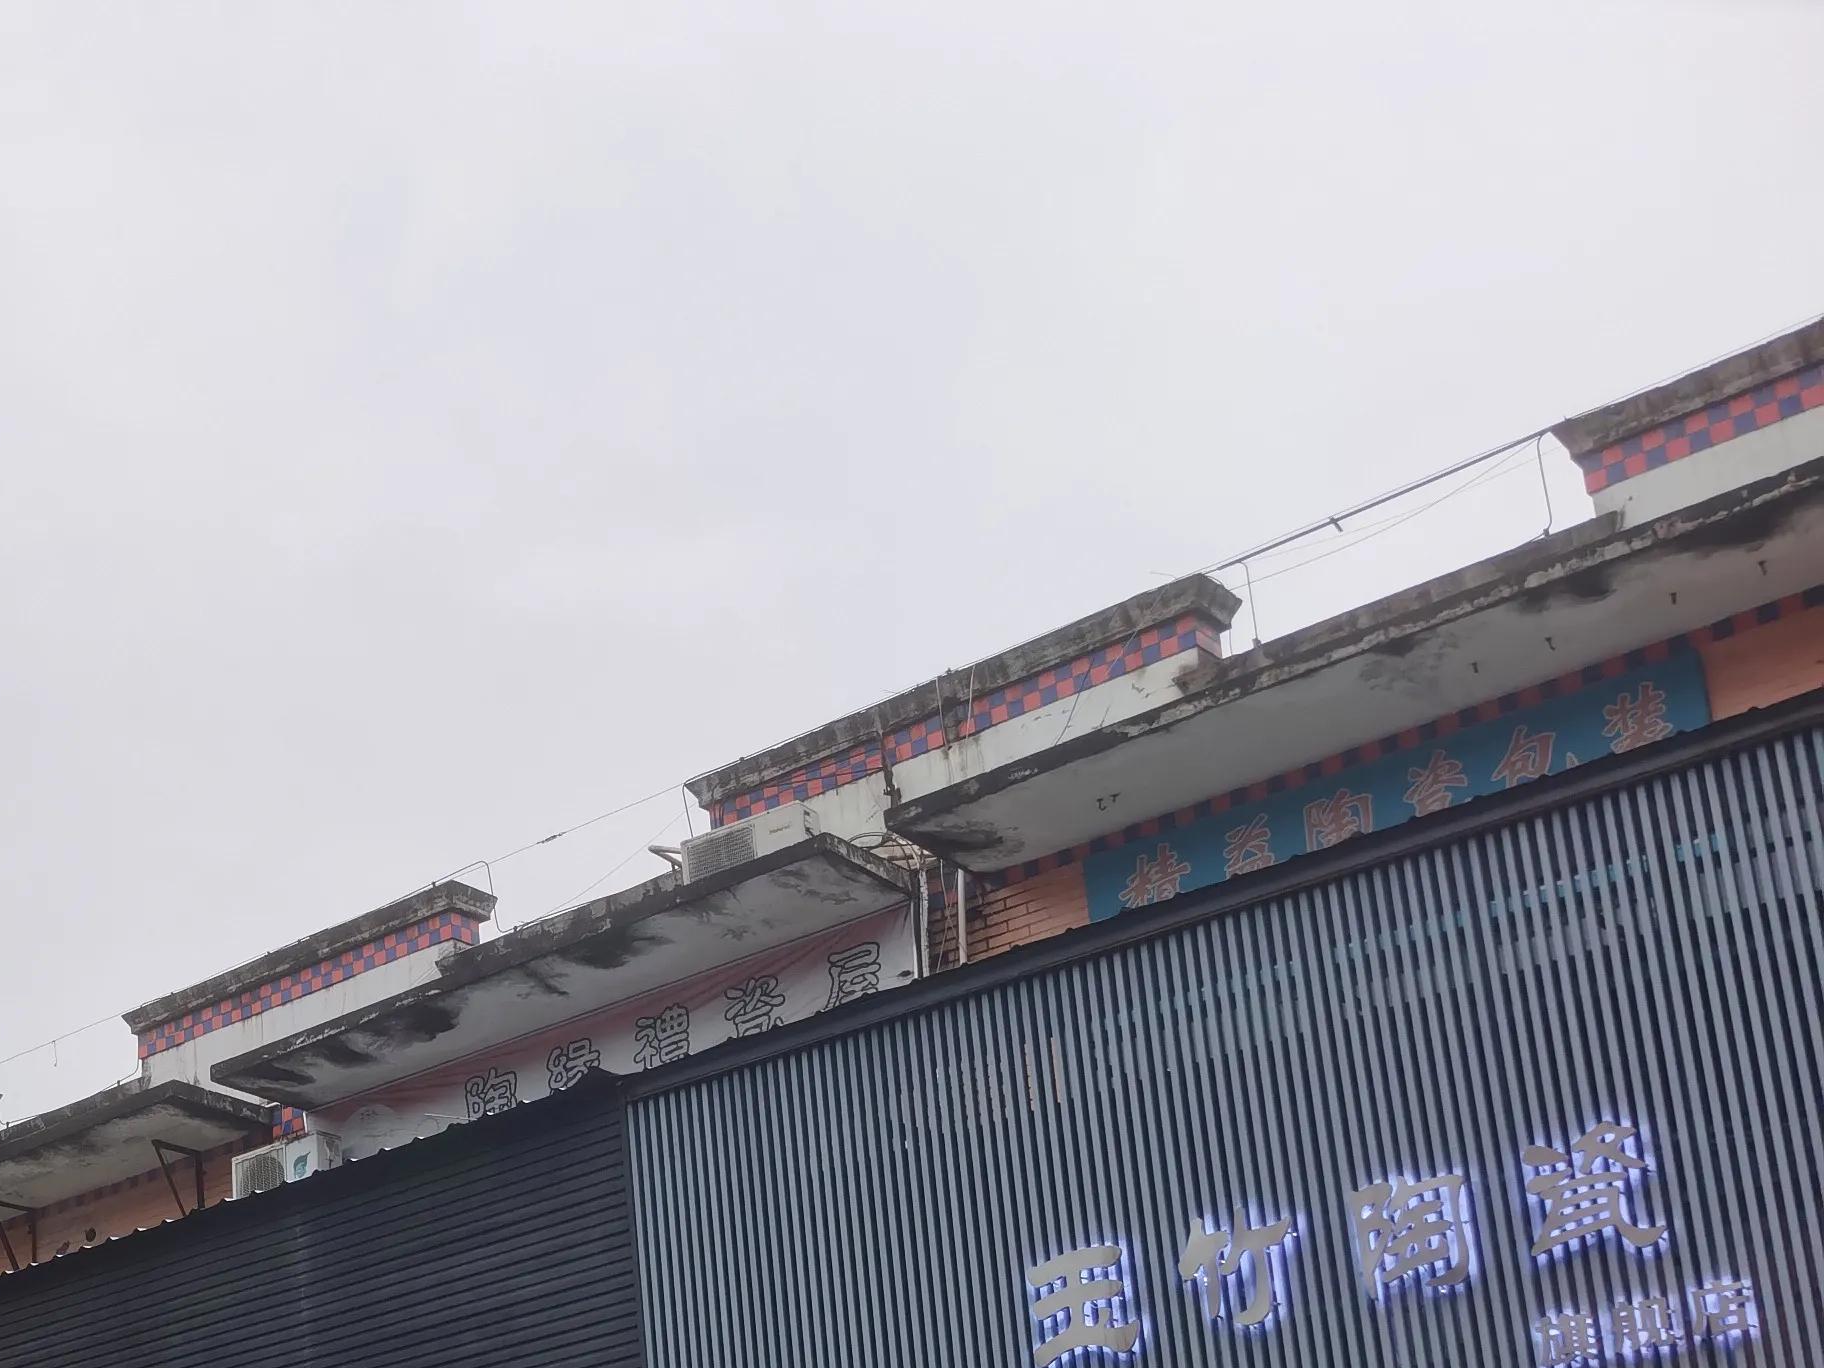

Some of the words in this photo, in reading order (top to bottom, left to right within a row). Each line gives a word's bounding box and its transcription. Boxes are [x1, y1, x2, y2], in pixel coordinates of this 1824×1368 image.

[1025, 1120, 1668, 1368] 玉竹陶瓷
[1535, 1280, 1751, 1367] 旗舰店
